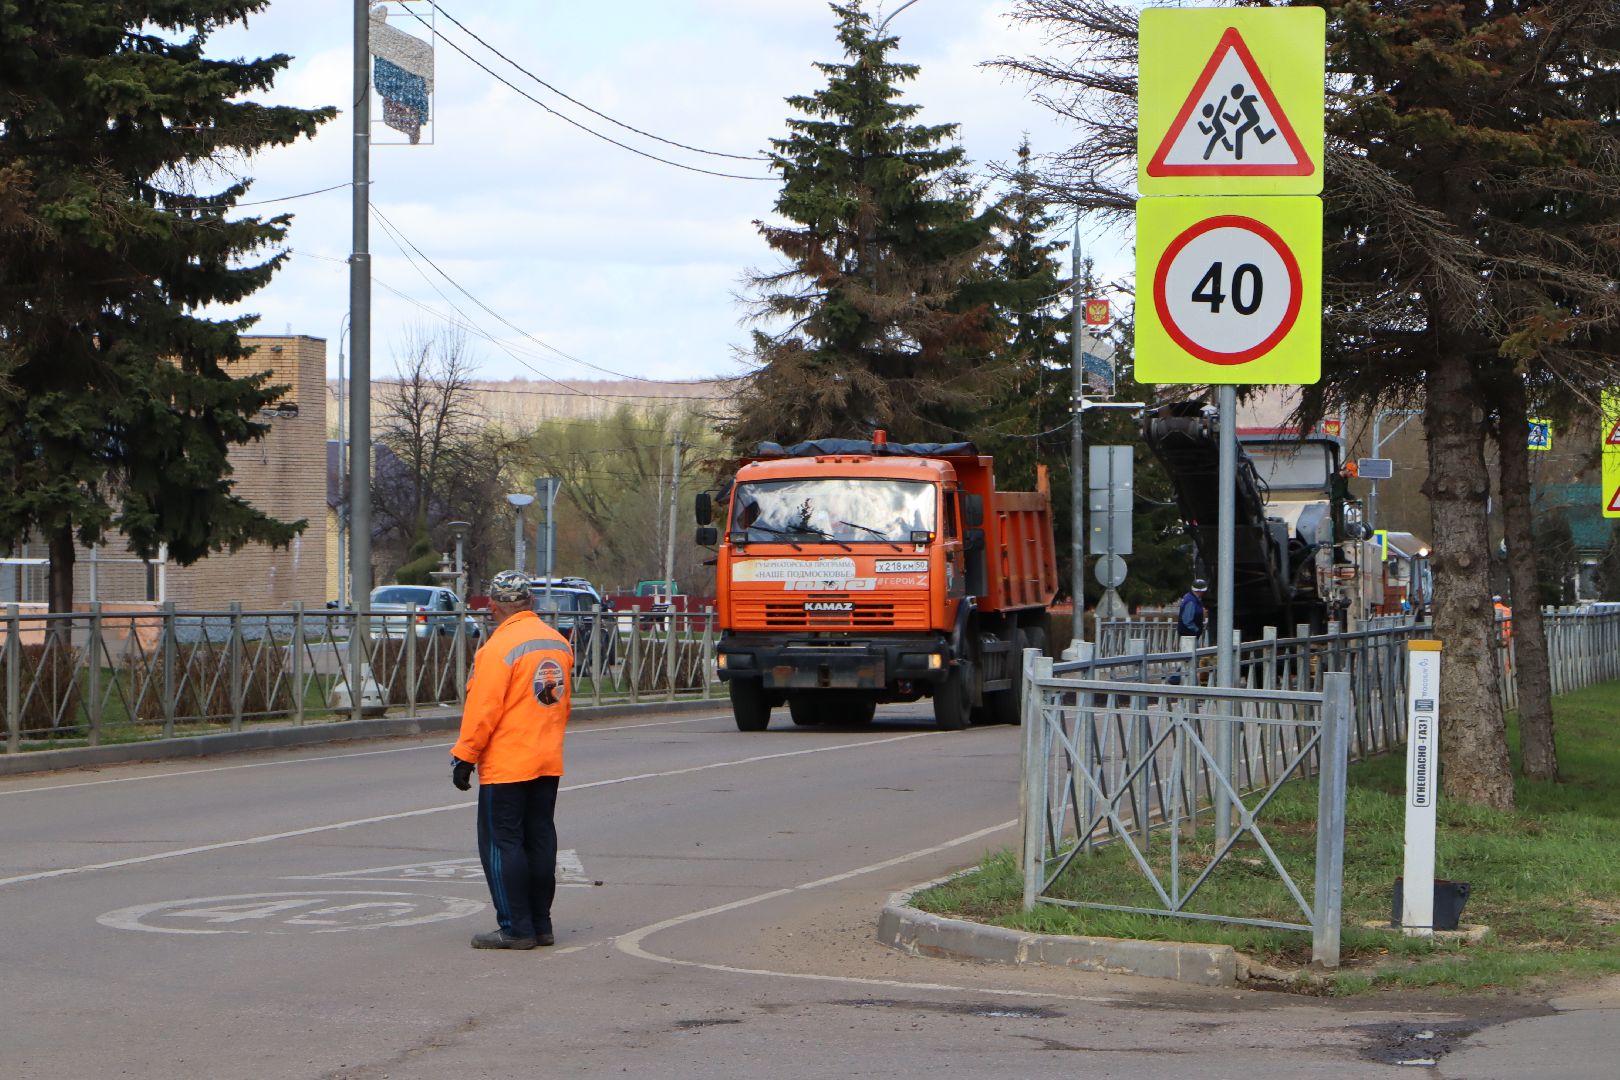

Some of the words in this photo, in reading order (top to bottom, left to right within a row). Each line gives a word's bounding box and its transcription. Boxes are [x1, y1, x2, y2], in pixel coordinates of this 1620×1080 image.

[1191, 261, 1263, 316] 40
[755, 570, 785, 579] «НАШЕ
[804, 602, 853, 611] KAMAZ
[1416, 745, 1427, 804] ОГНЕОПАСНО
